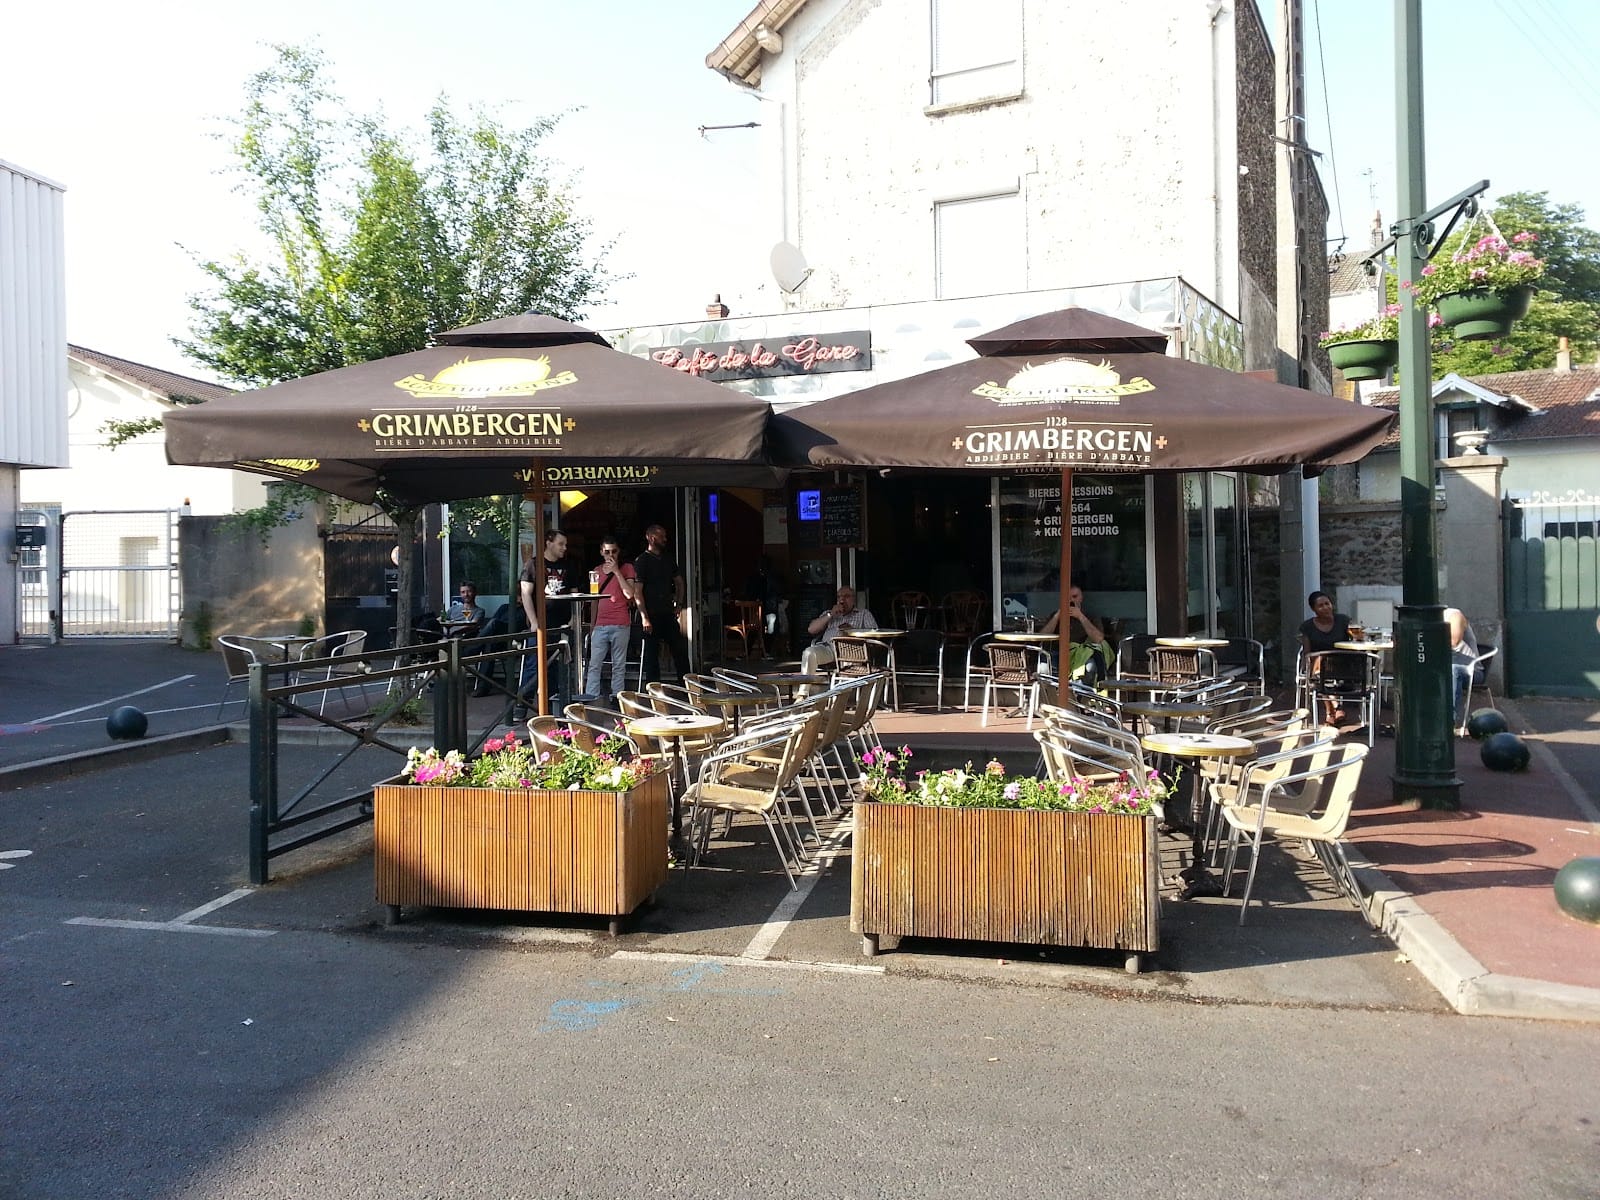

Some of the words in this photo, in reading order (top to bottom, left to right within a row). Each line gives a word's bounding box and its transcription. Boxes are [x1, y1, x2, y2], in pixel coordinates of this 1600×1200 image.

[719, 345, 750, 369] de
[751, 343, 778, 368] la
[782, 337, 859, 370] Gare
[371, 413, 563, 437] GRIMBERGEN
[1046, 416, 1068, 427] 1128
[375, 437, 411, 446] BIÈRE
[419, 438, 478, 446] D'ABBAYE
[496, 438, 561, 446] ABDIJBIER
[966, 428, 1152, 454] GRIMBERGEN
[966, 453, 1030, 463] ABDIJBIER
[1047, 451, 1083, 460] BIÈRE
[1090, 453, 1151, 463] D'ABBAYE
[1028, 487, 1061, 498] BIERES
[1071, 502, 1091, 513] 664
[1043, 513, 1114, 526] GRIBERGEN
[1044, 525, 1120, 537] KROENBOURG
